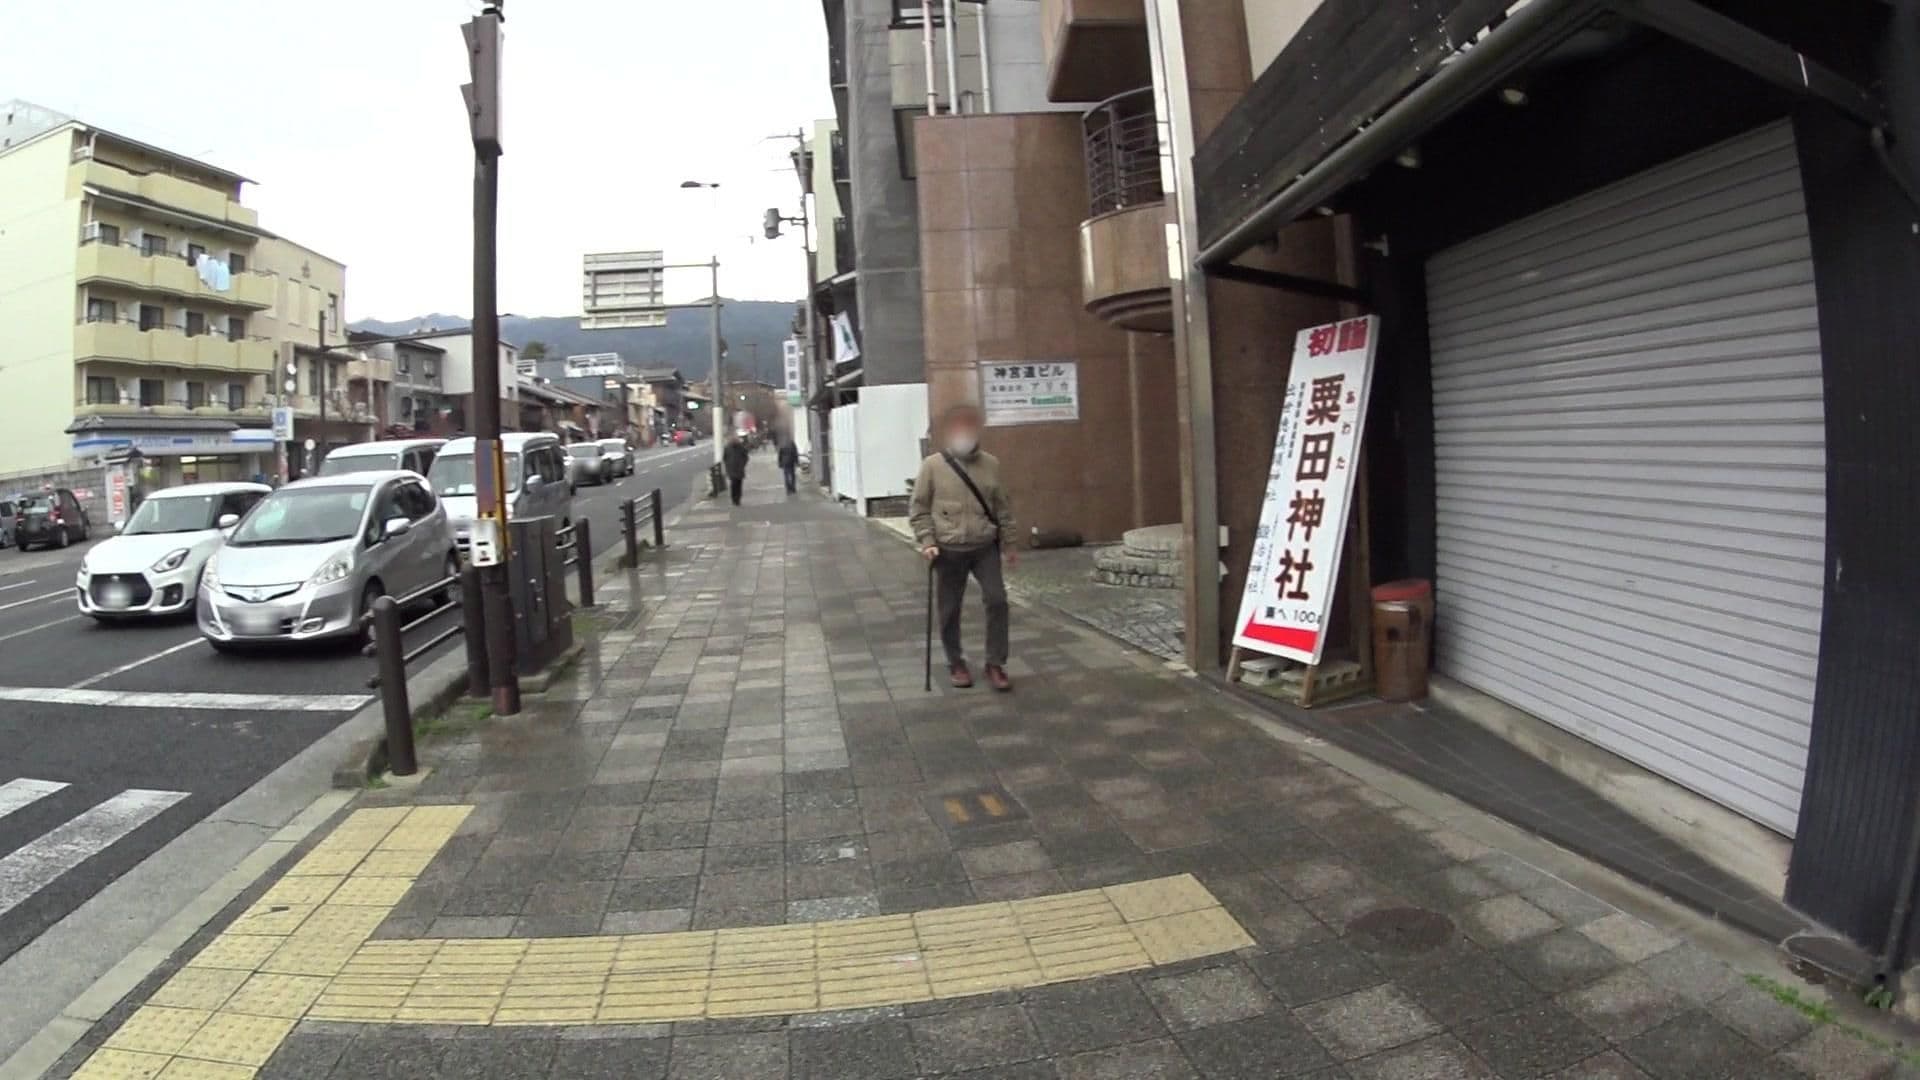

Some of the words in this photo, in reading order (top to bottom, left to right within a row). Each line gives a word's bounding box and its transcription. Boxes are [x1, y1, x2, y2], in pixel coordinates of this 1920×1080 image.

[994, 365, 1064, 378] 神宮道ビル
[1274, 373, 1345, 600] 粟田神社
